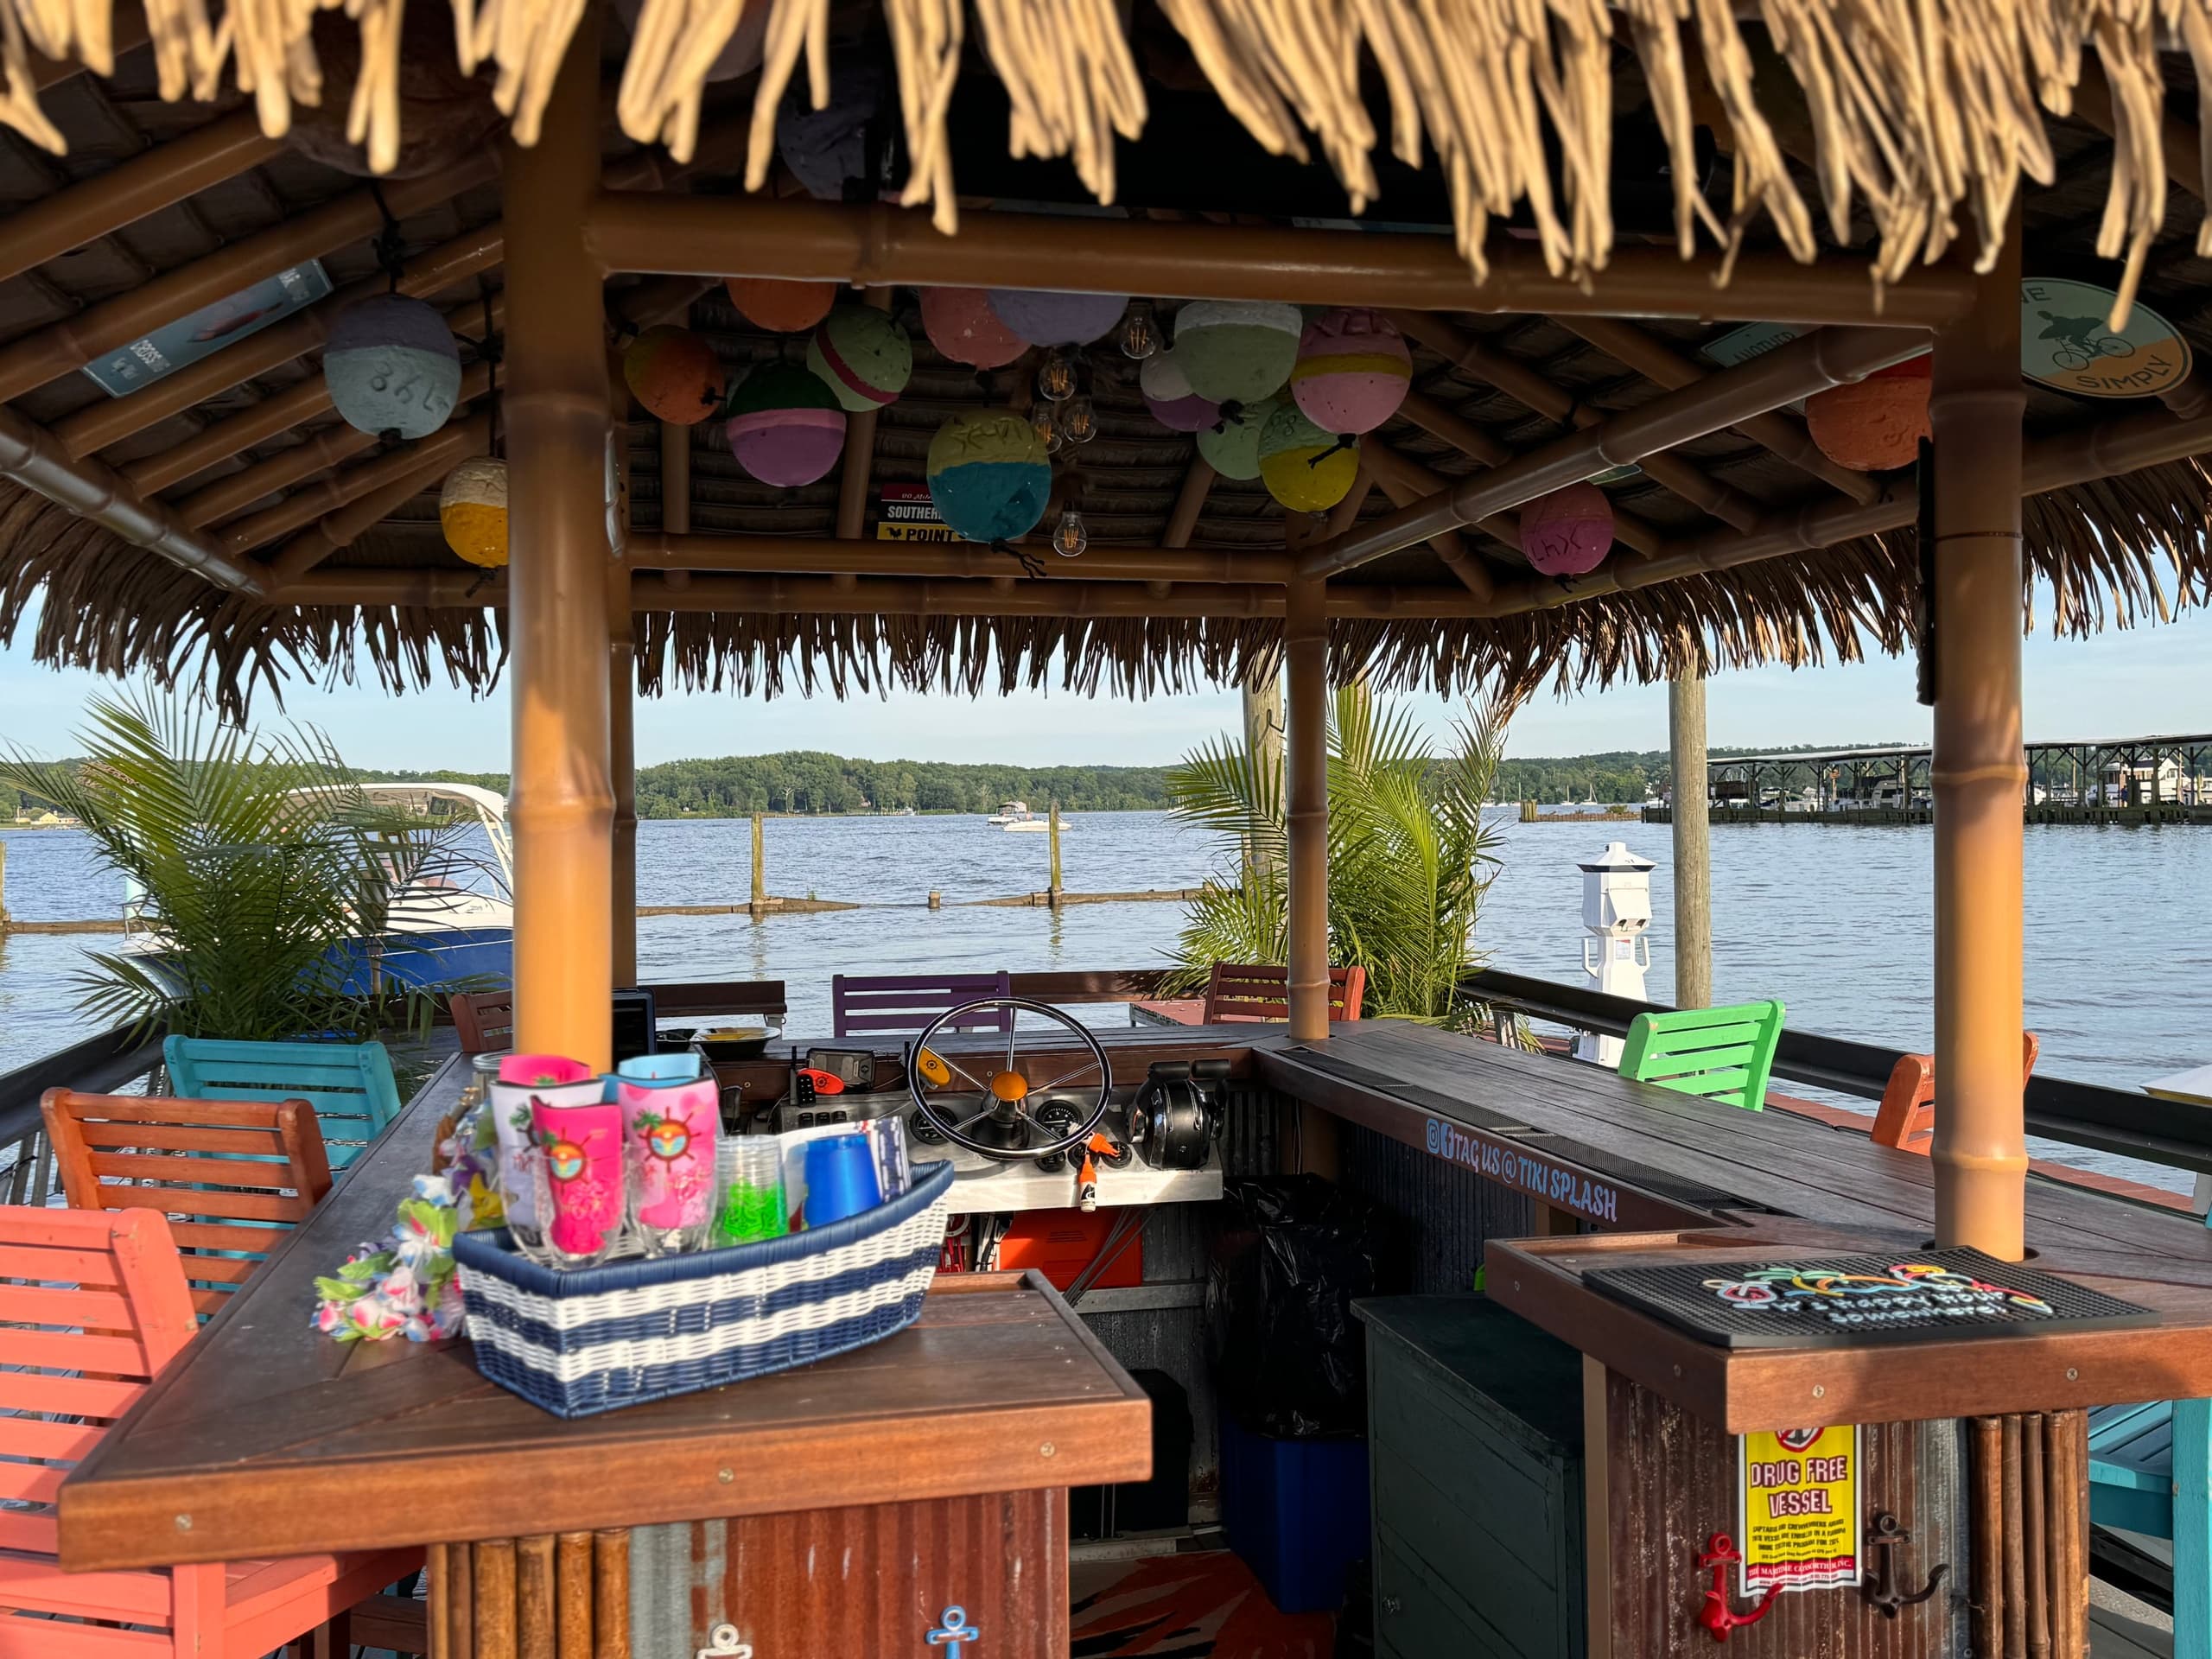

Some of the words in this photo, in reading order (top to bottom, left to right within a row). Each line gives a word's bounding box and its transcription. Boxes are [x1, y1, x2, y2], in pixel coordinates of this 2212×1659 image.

[2075, 354, 2172, 390] SIMPLY
[887, 505, 941, 520] SOUTHER
[906, 529, 955, 543] POINT
[1454, 1134, 1479, 1173] TAG
[1481, 1144, 1501, 1175] US
[1517, 1156, 1548, 1195] TIKI
[1550, 1171, 1618, 1223] SPLASH
[1750, 1459, 1801, 1488] DRUG
[1806, 1455, 1847, 1484] FREE
[1768, 1489, 1833, 1518] VESSEL
